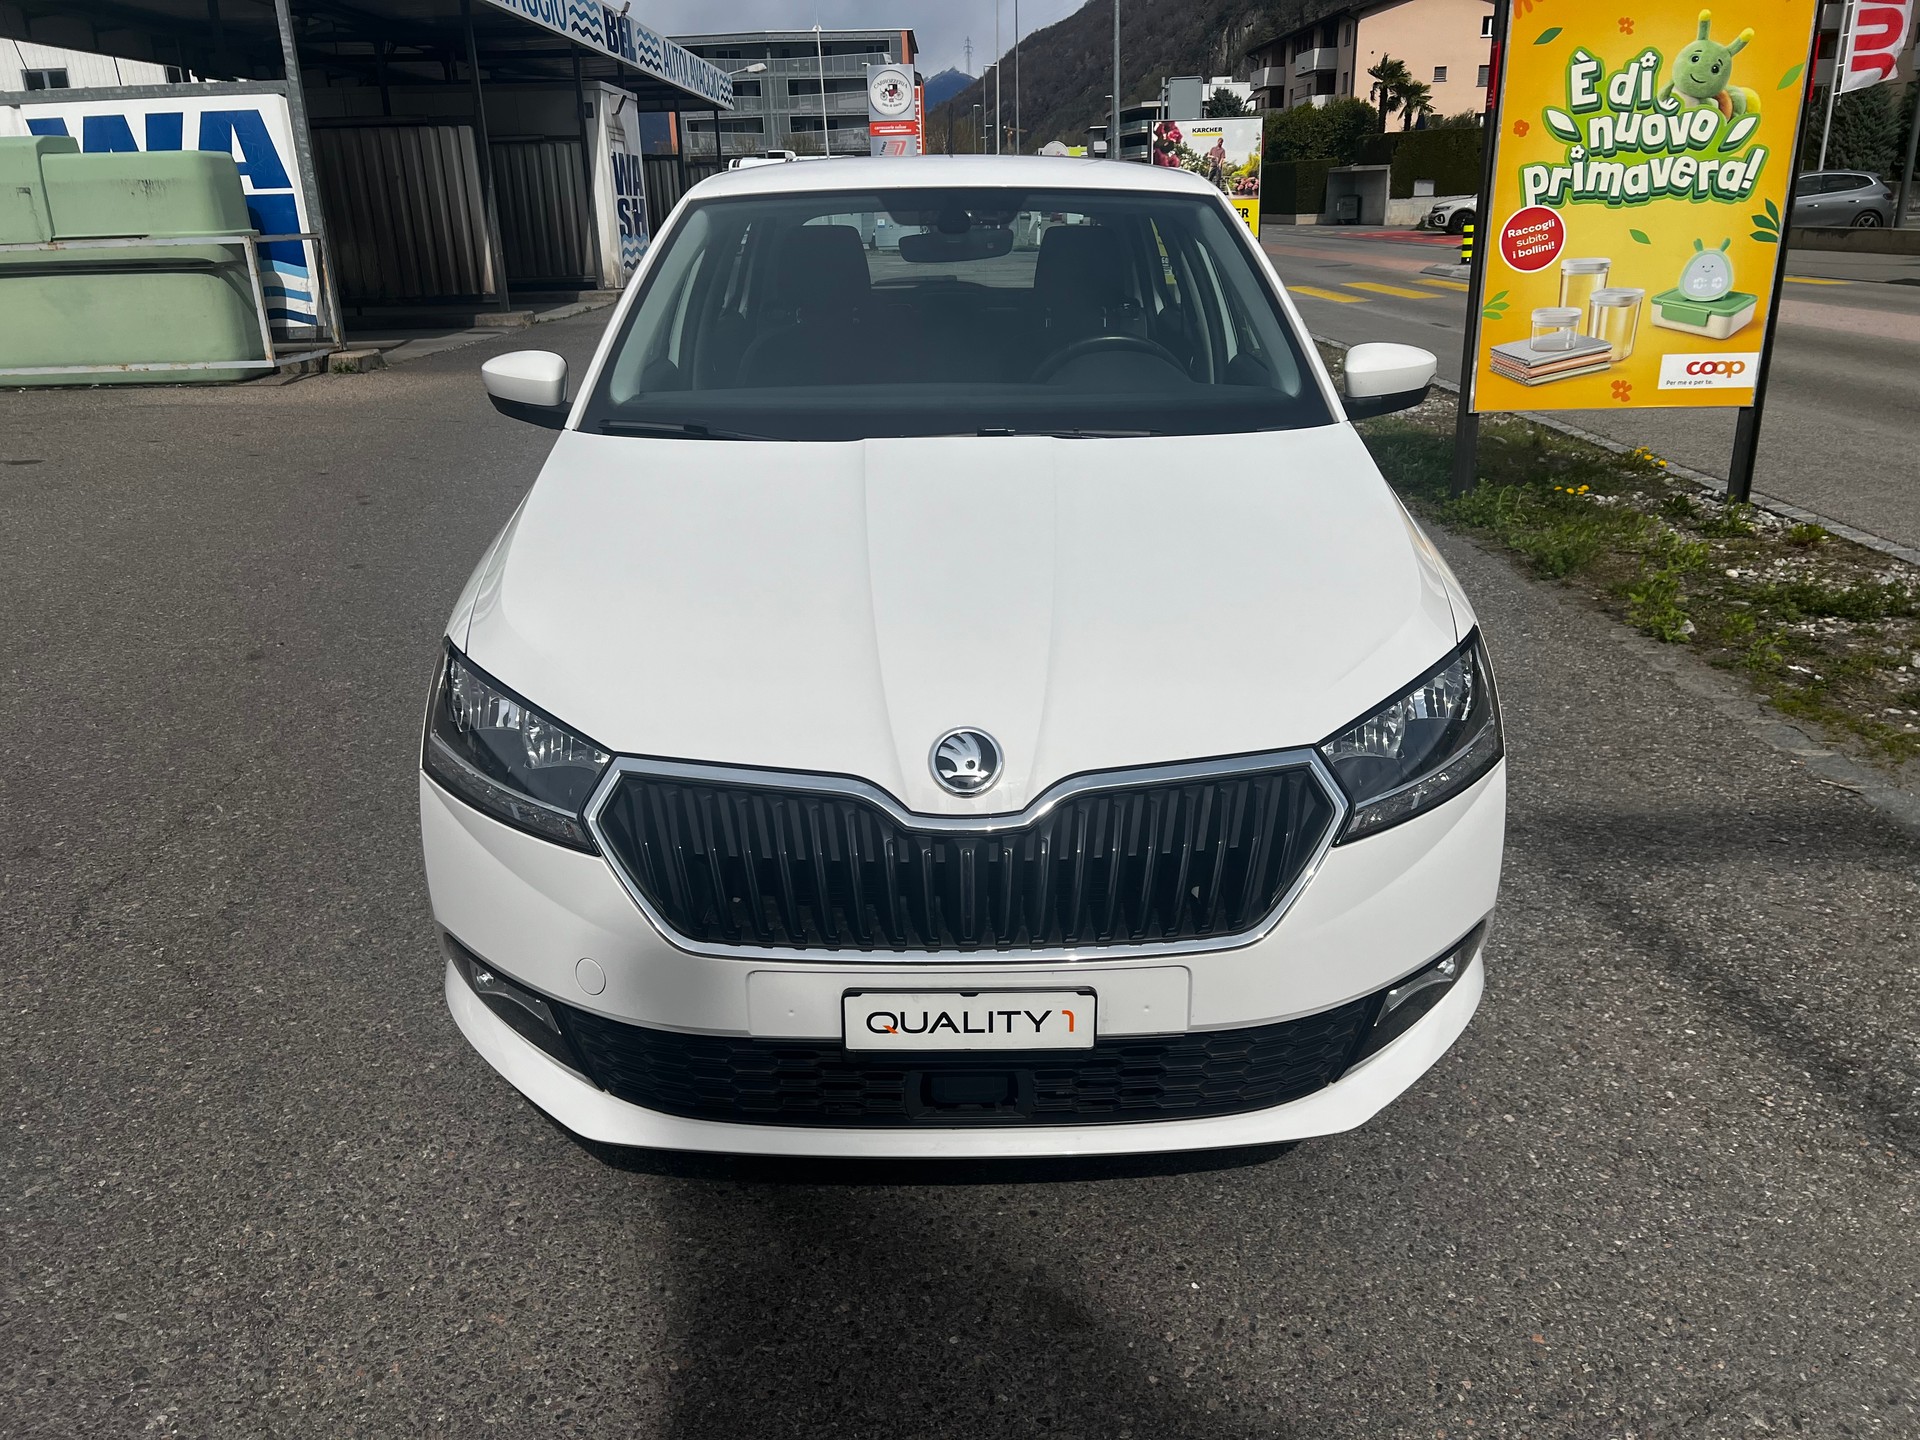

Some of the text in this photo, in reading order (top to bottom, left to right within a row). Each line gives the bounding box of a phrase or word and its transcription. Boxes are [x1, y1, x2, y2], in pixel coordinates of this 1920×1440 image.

[602, 5, 638, 63] BEL
[663, 40, 720, 101] AUTOLAVAGGIO
[1851, 0, 1906, 80] JU
[1571, 50, 1657, 106] È di
[1588, 109, 1719, 150] nuovo
[1523, 146, 1766, 207] primavera!
[1507, 218, 1555, 238] Raccogli
[1516, 233, 1549, 247] subito
[1512, 241, 1555, 259] i bollini!
[1686, 360, 1746, 379] coop
[866, 1009, 1075, 1034] QUALITY 1
